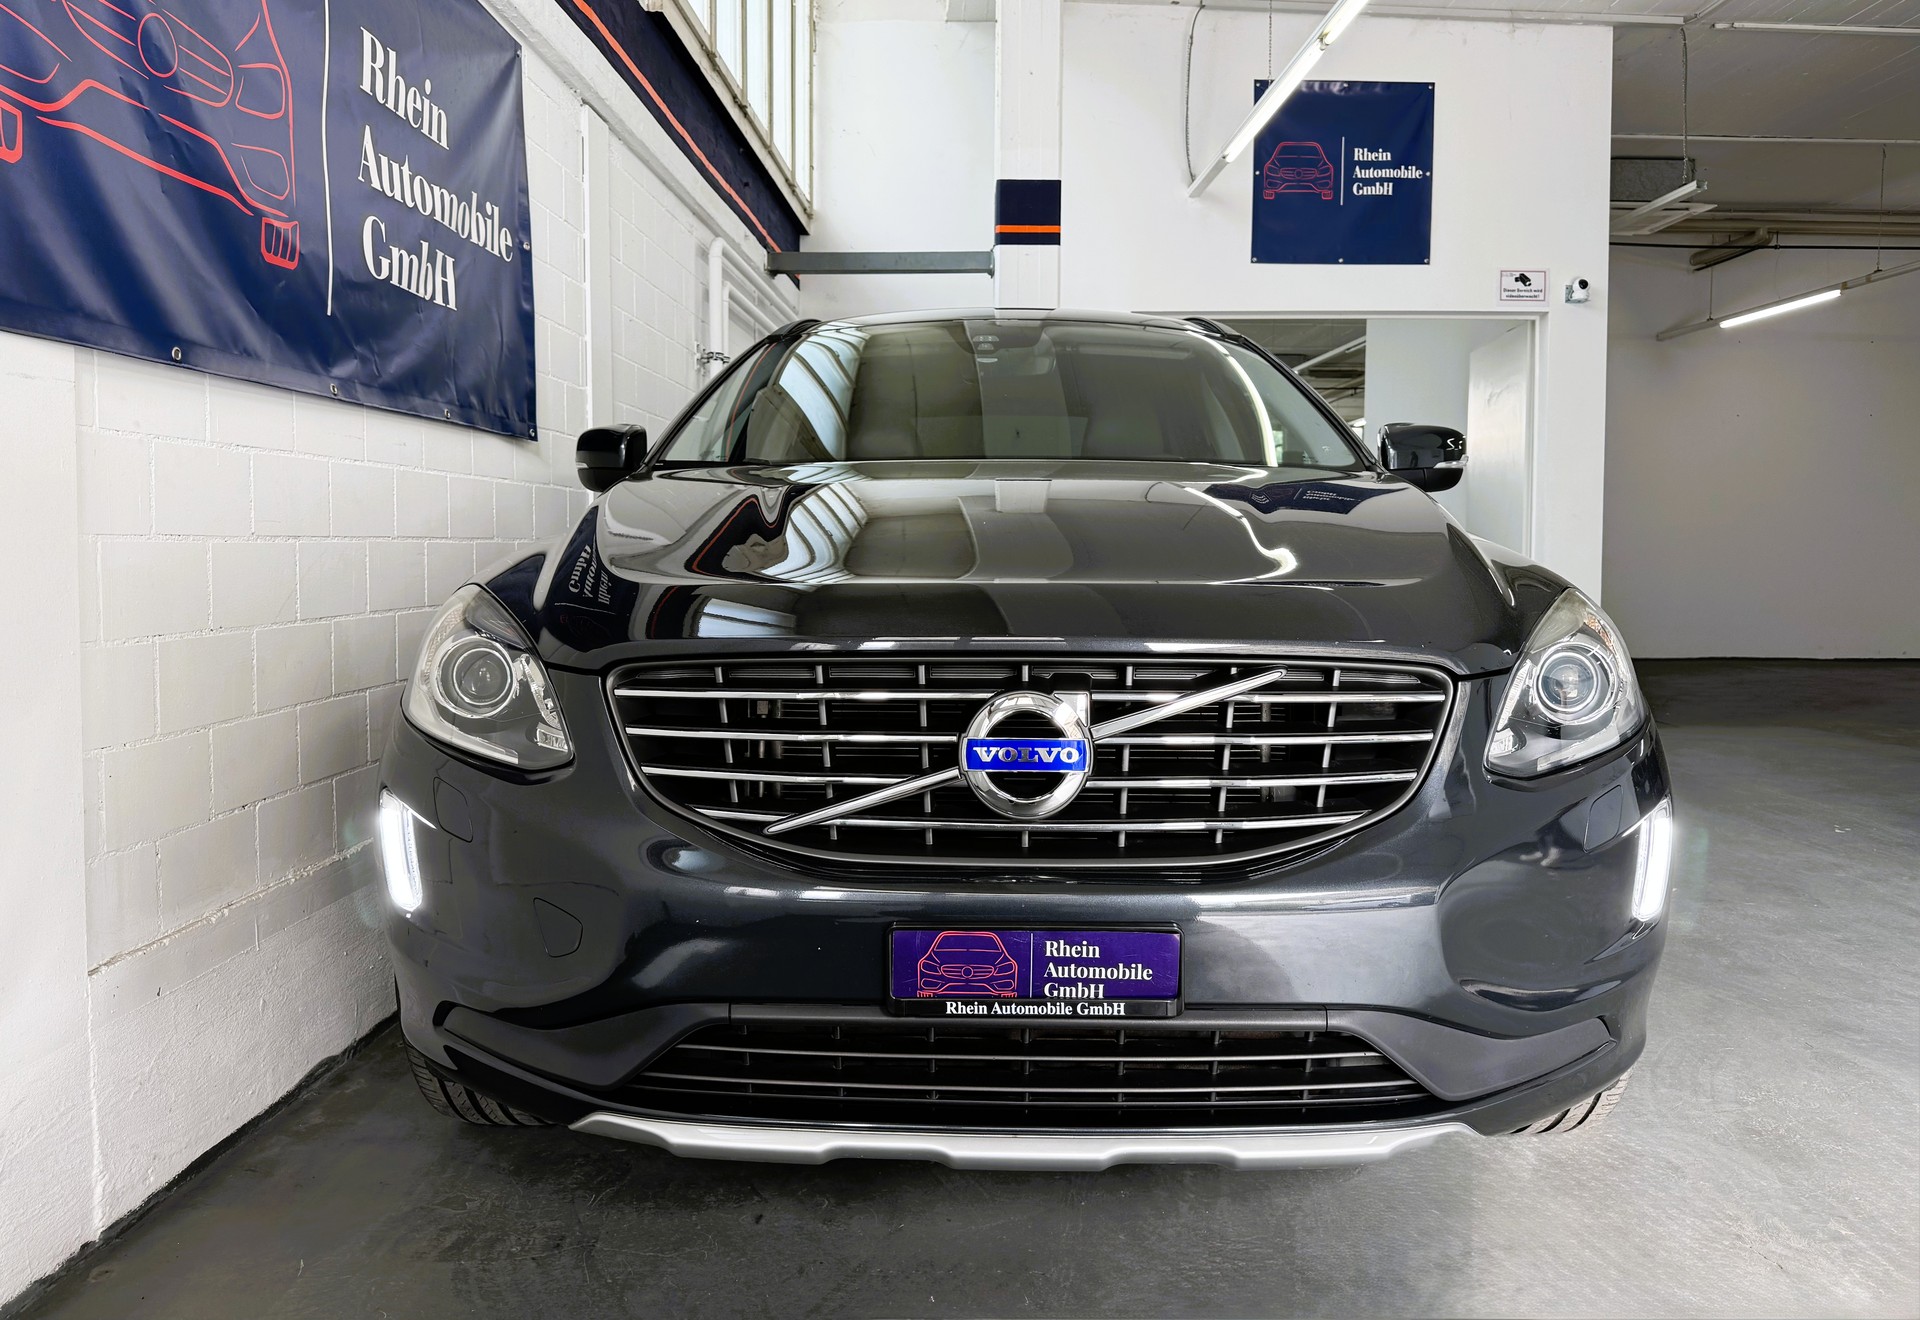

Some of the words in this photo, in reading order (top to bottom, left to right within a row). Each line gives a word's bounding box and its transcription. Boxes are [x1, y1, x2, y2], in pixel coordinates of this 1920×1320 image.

[360, 26, 449, 150] Rhein
[1353, 147, 1392, 161] Rhein
[1352, 165, 1423, 179] Automobile
[358, 124, 513, 262] Automobile
[1352, 182, 1393, 196] GmbH
[362, 215, 457, 311] GmbH
[972, 746, 1080, 763] VOLVO
[1045, 939, 1101, 958] Rhein
[1043, 962, 1154, 980] Automobile
[1043, 982, 1105, 999] GmbH
[946, 1001, 988, 1015] Rhein
[991, 1001, 1073, 1016] Automobile
[1076, 1002, 1126, 1016] GmbH
